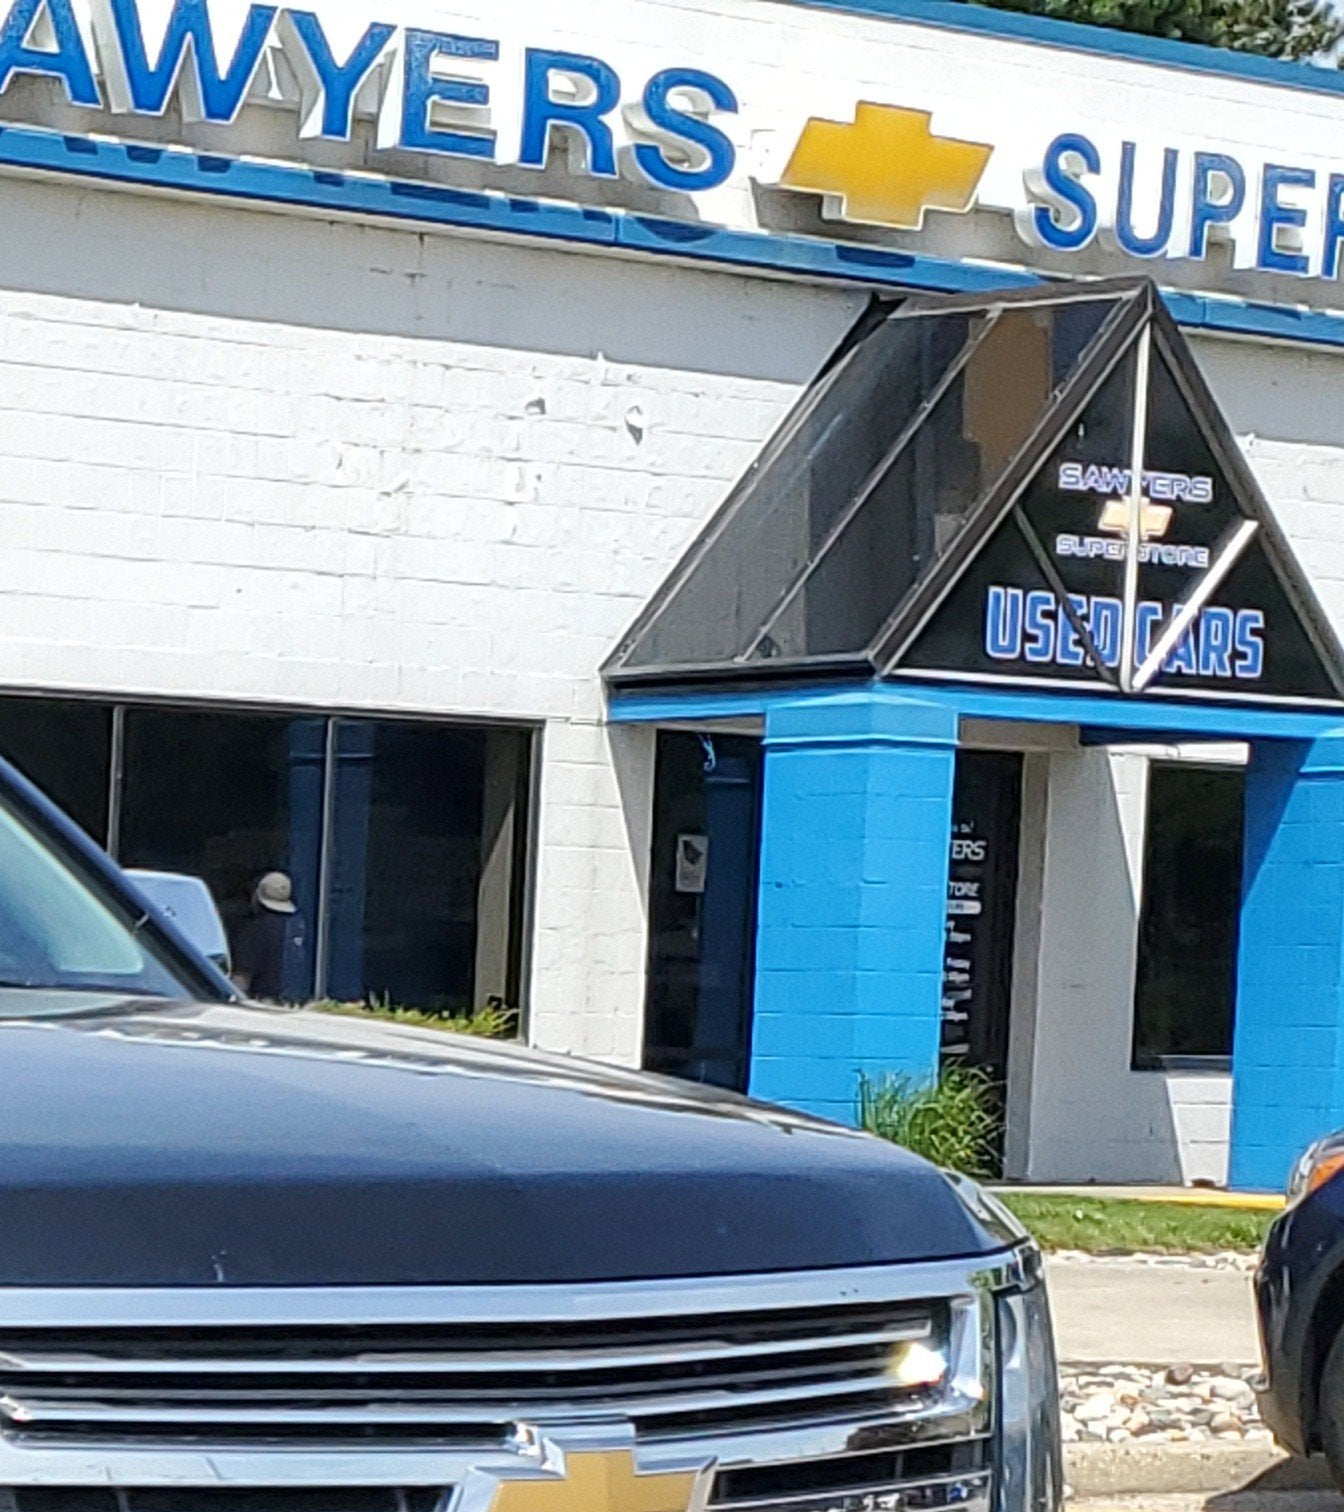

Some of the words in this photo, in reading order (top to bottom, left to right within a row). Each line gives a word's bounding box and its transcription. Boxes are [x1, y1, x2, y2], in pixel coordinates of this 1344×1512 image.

[1055, 533, 1210, 568] SUPESTORE
[985, 585, 1123, 668] USED
[1133, 600, 1265, 678] CARS
